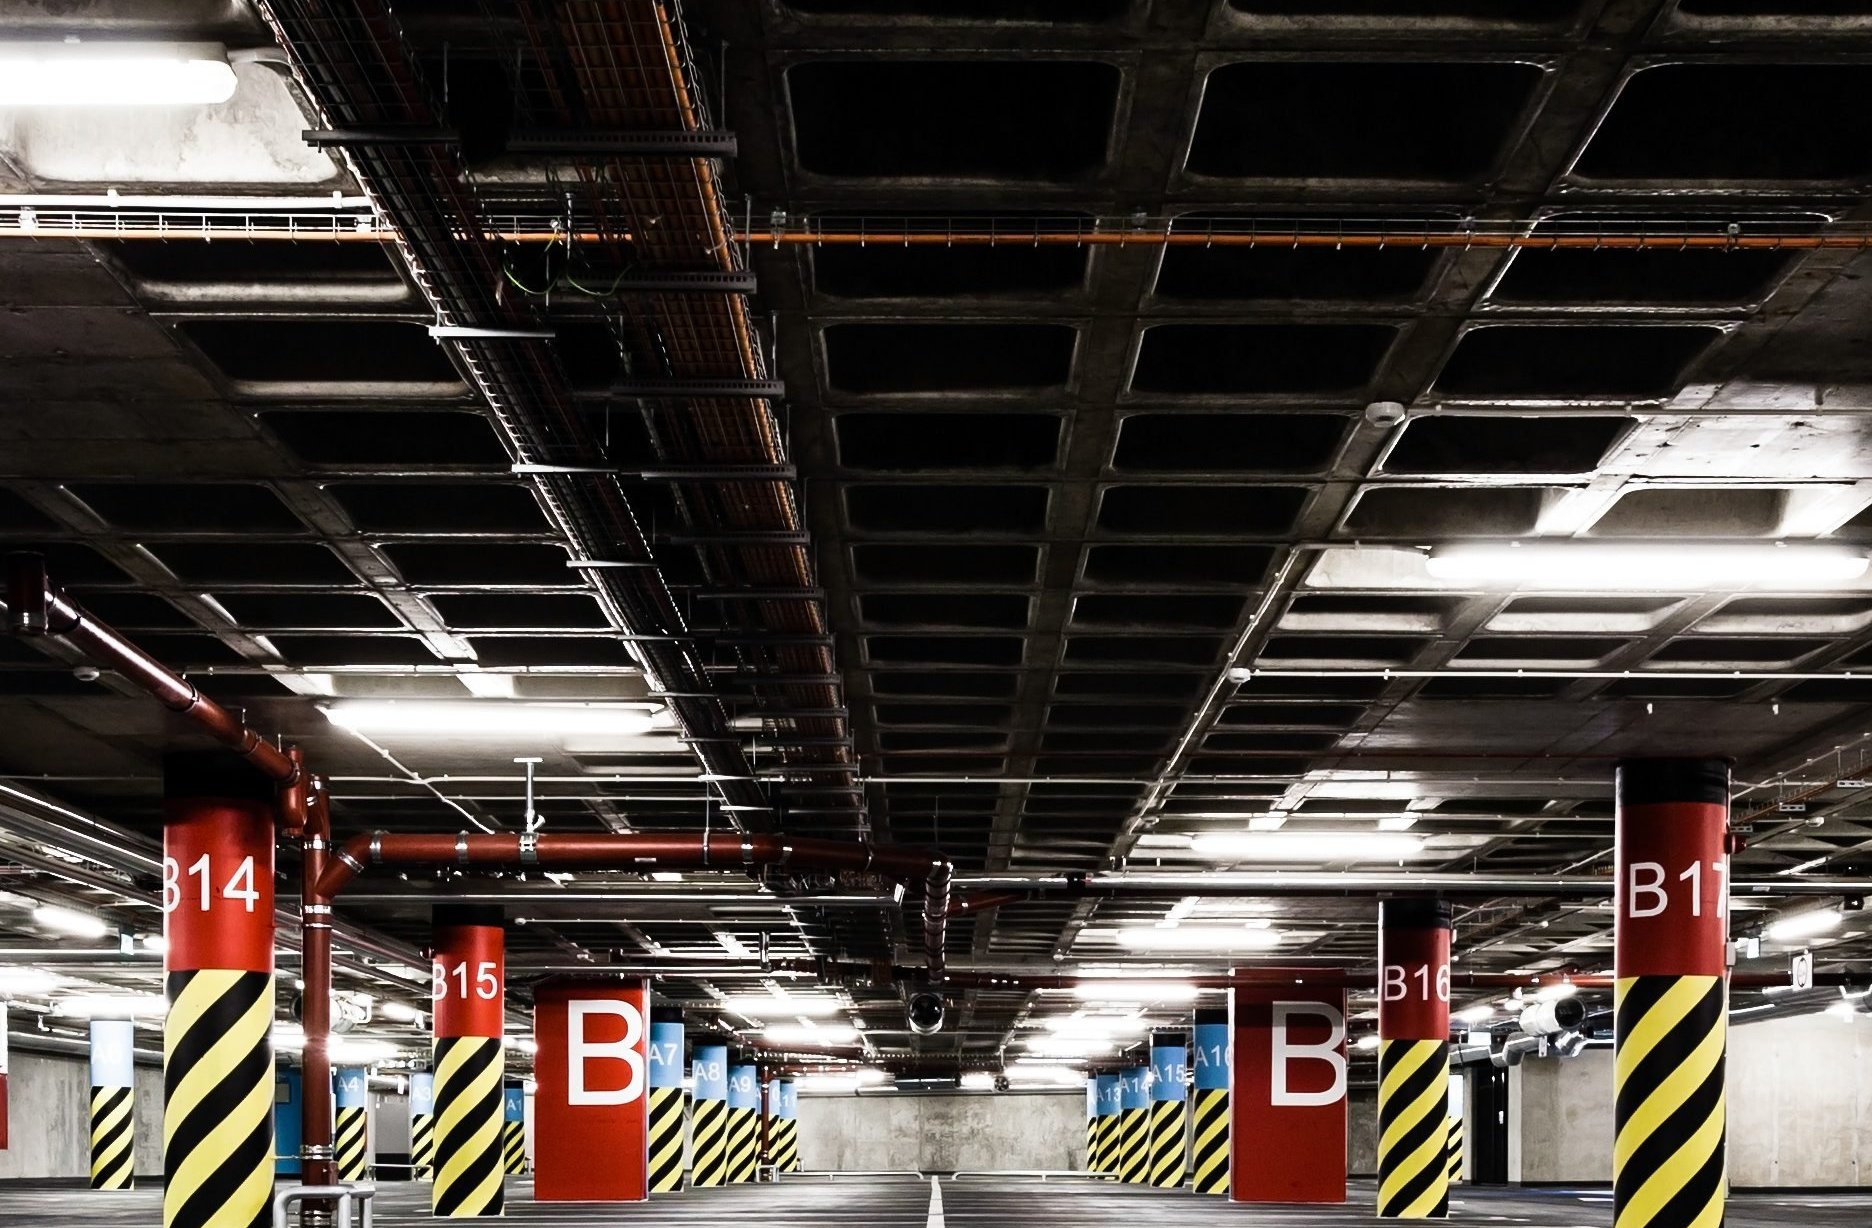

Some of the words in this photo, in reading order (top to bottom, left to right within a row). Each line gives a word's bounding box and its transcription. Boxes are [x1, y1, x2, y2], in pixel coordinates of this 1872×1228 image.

[433, 961, 498, 1000] B15
[1384, 963, 1450, 1002] B16
[568, 999, 644, 1106] B
[648, 1043, 678, 1066] A7
[1271, 1001, 1347, 1106] B
[338, 1076, 360, 1093] A4
[694, 1062, 721, 1081] A8
[729, 1075, 751, 1093] A9
